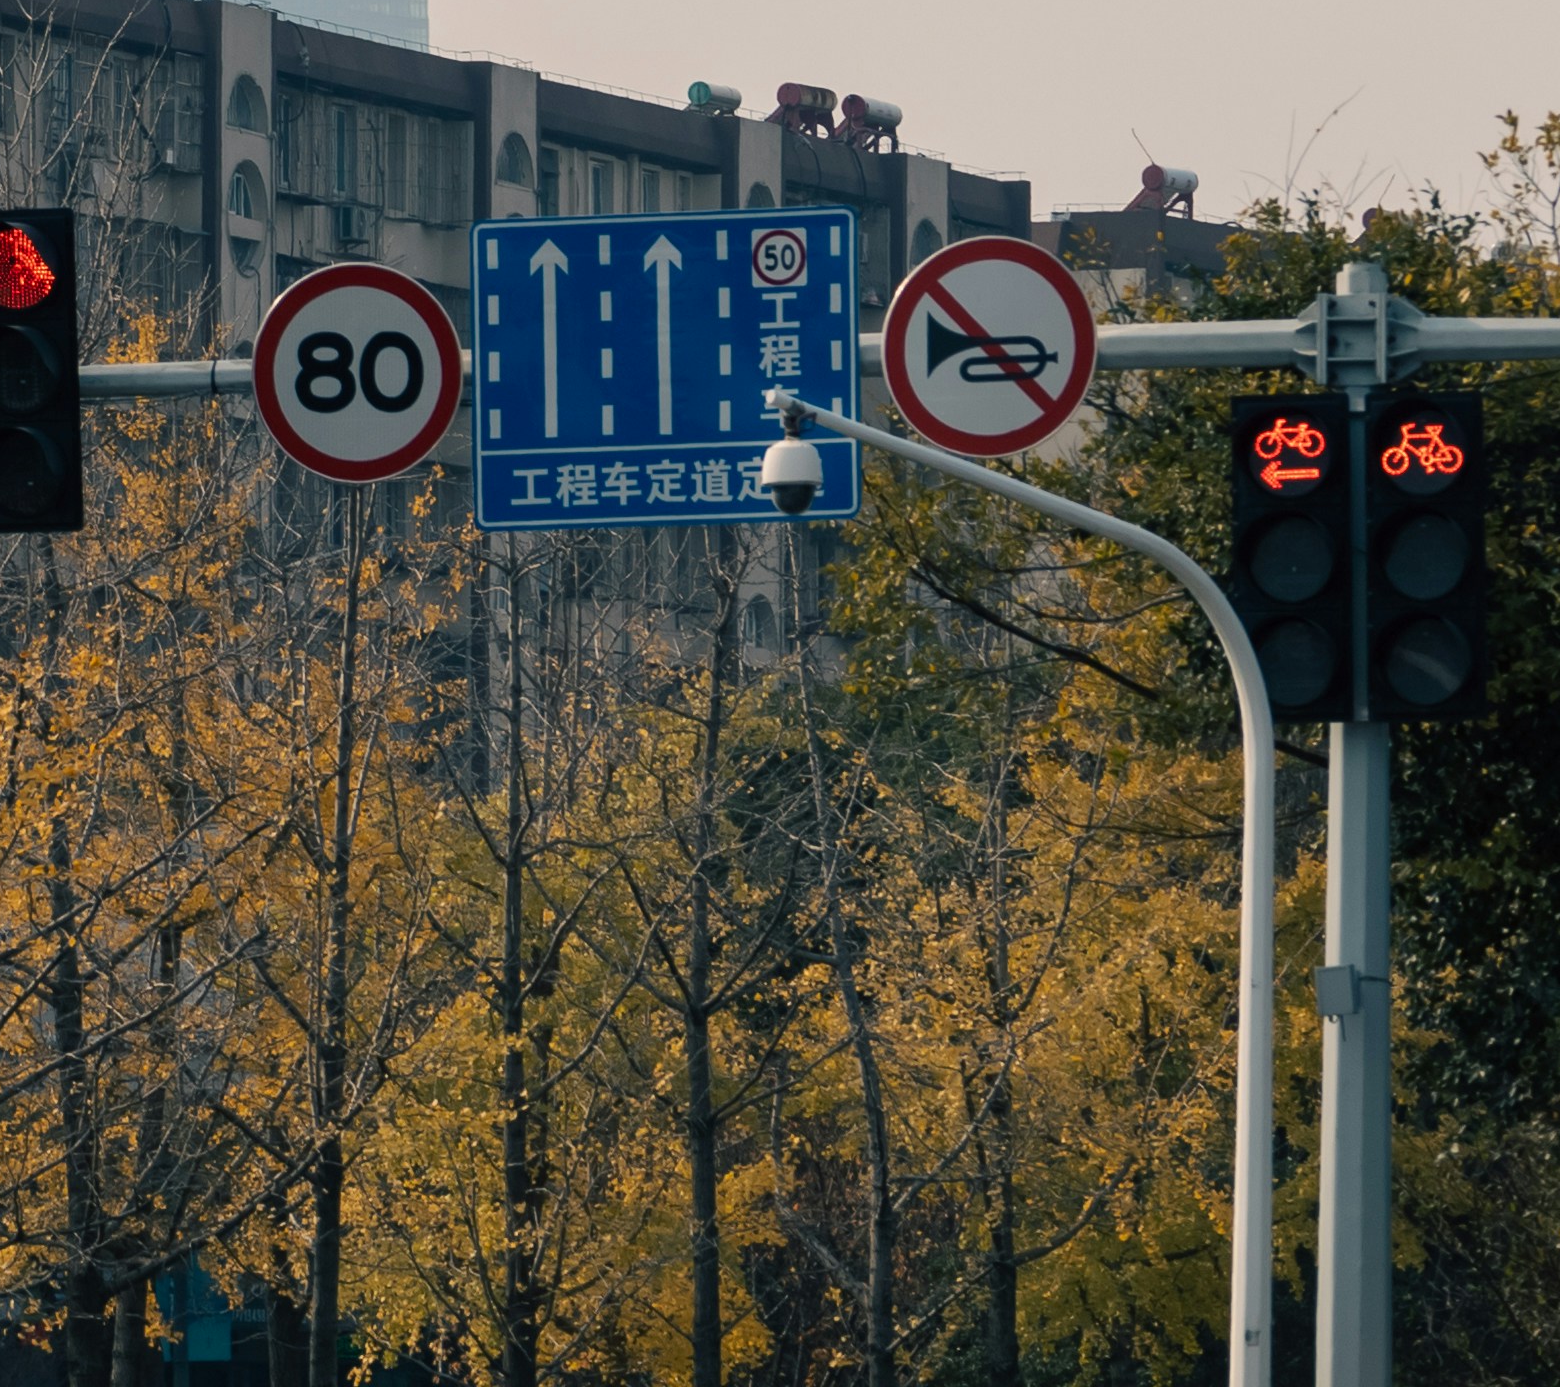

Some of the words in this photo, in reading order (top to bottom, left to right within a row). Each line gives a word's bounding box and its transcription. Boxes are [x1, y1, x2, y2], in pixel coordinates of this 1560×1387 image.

[764, 244, 796, 272] 50
[294, 330, 425, 414] 80
[510, 457, 825, 507] 工程车定道定
